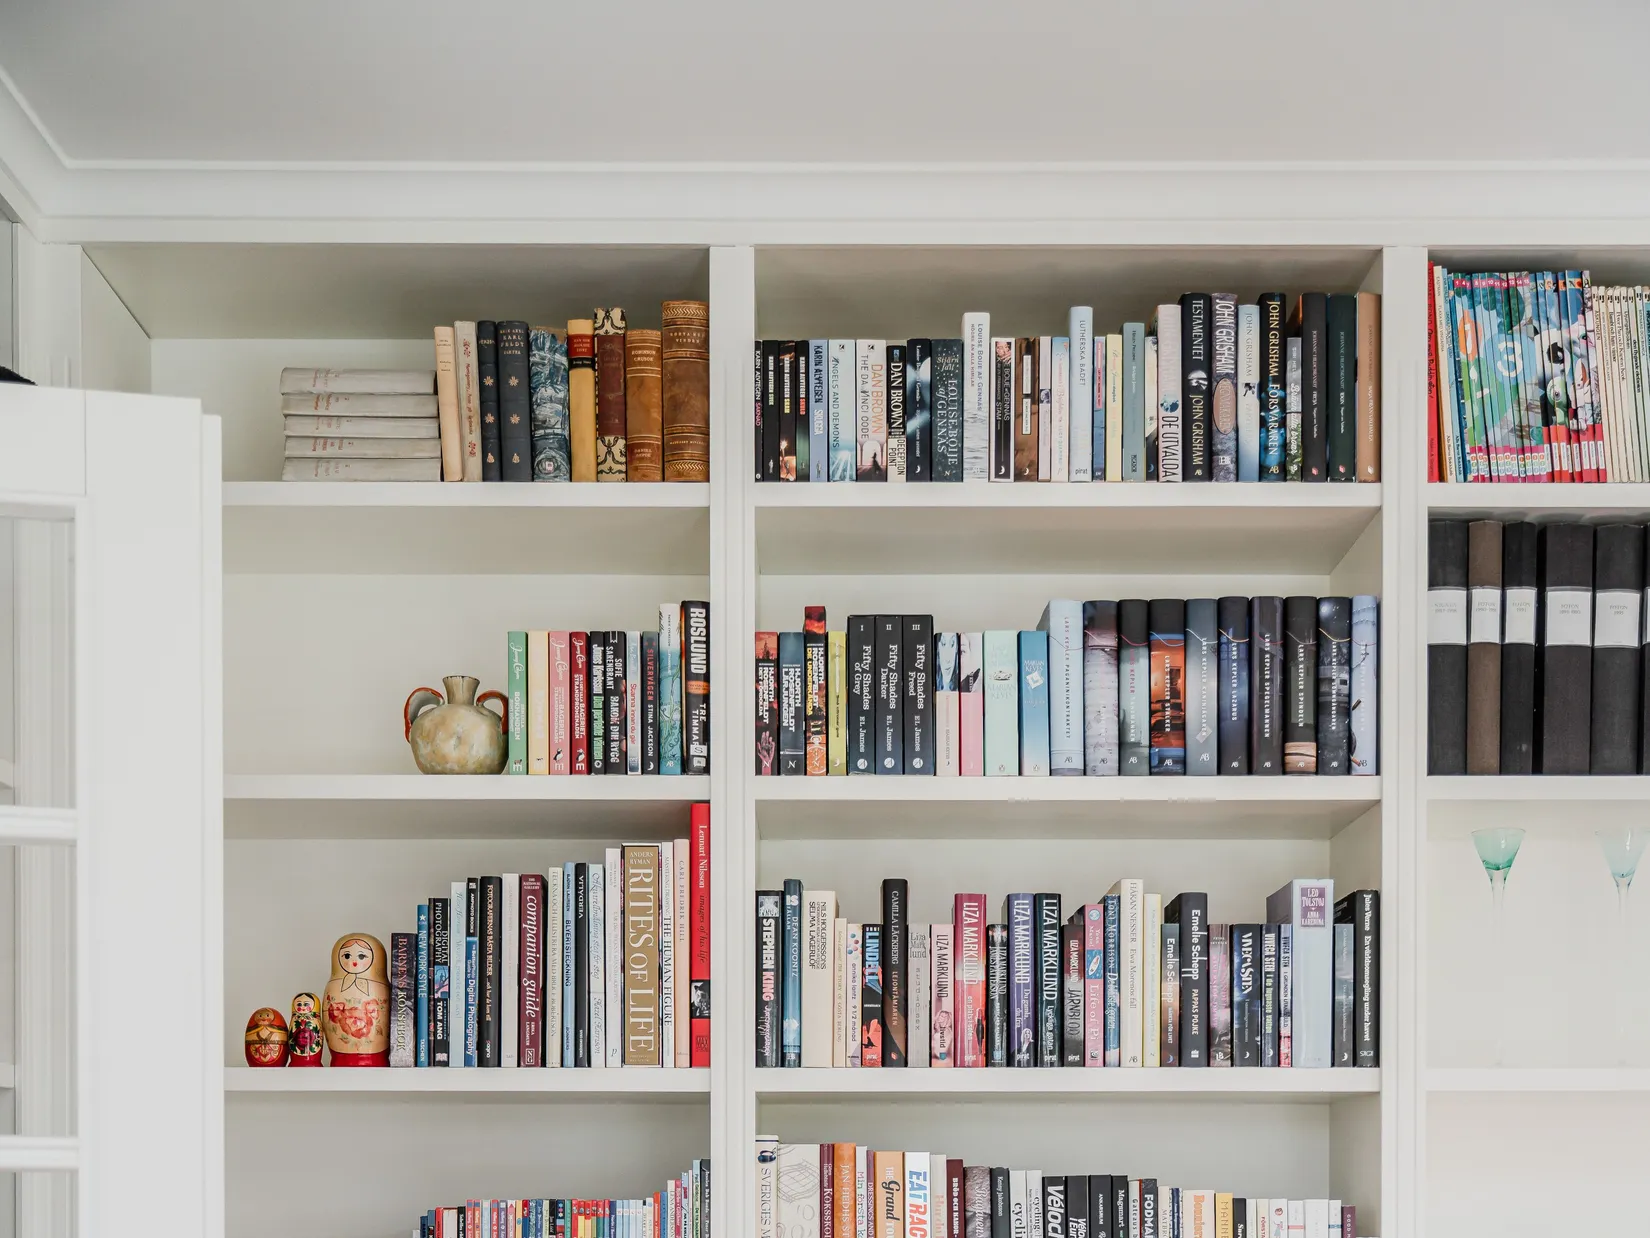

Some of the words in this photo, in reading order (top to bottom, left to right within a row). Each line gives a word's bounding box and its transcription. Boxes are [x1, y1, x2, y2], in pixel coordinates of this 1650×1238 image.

[1215, 299, 1235, 327] JOHN
[1244, 313, 1253, 335] JOHN
[1267, 301, 1281, 329] JOHN
[1079, 320, 1087, 361] LUTHERSKA
[1192, 300, 1204, 361] TESTAMENTET
[1215, 328, 1235, 374] GRISHAM
[1245, 337, 1253, 378] GRISHAM
[1268, 330, 1280, 377] GRISHAM
[831, 356, 840, 389] ANGELS
[870, 363, 884, 388] DAN
[890, 361, 903, 387] DAN
[1079, 364, 1087, 387] BADET
[832, 391, 840, 410] AND
[870, 390, 884, 435] BROWN
[889, 389, 903, 429] BROWN
[948, 379, 958, 425] LOUISE
[1189, 395, 1203, 421] JOHN
[832, 411, 841, 448] DEMONS
[1160, 415, 1179, 430] DE
[1268, 383, 1283, 455] FÖRSVARAREN
[888, 447, 897, 468] POINT
[896, 439, 906, 477] DECEPTION
[946, 430, 959, 466] BOIJE
[1160, 432, 1179, 478] UTVALDA
[1192, 422, 1204, 466] GRISHAM
[592, 644, 604, 664] Jonas
[690, 608, 706, 674] ROSLUND
[887, 644, 898, 670] Fifty
[915, 644, 926, 670] Fifty
[1231, 642, 1239, 660] LARS
[606, 646, 615, 690] SARENBRANT
[614, 658, 622, 678] SOFIE
[646, 648, 657, 701] SILVERVÄGEN
[860, 645, 871, 671] Fifty
[1231, 662, 1239, 687] KEPLER
[592, 666, 604, 693] Karlsson
[862, 673, 872, 711] Shades
[880, 669, 888, 700] Darker
[888, 672, 898, 710] Shades
[908, 672, 916, 697] Freed
[917, 672, 926, 709] Shades
[593, 696, 604, 708] Den
[609, 696, 620, 724] BAKOM
[782, 668, 790, 727] LÄRJUNGEN
[1231, 690, 1239, 721] LAZARUS
[591, 710, 604, 736] perfekte
[609, 725, 620, 740] DIN
[593, 737, 604, 759] vännen
[610, 741, 620, 763] RYGG
[698, 825, 708, 858] Lennart
[698, 860, 708, 889] Nilsson
[628, 867, 655, 949] RITES
[891, 890, 899, 924] CAMILLA
[1013, 900, 1032, 922] LIZA
[1042, 899, 1058, 926] LIZA
[1129, 882, 1139, 911] HÅKAN
[663, 916, 673, 939] THE
[791, 917, 799, 940] DEAN
[808, 901, 816, 928] SELMA
[963, 902, 979, 925] LIZA
[1129, 912, 1137, 943] NESSER
[418, 930, 427, 949] NEW
[435, 902, 443, 963] PHOTOGRAPHY
[441, 930, 449, 964] DIGITAL
[522, 895, 540, 975] companion
[762, 918, 775, 970] STEPHEN
[891, 925, 901, 965] LÄCKBERG
[935, 934, 949, 952] LIZA
[397, 937, 408, 988] BARNENS
[418, 950, 427, 973] YORK
[564, 920, 573, 987] BLYERTSTECKNING
[663, 941, 673, 984] HUMAN
[791, 943, 799, 978] KOONTZ
[808, 930, 818, 970] LAGERLÖF
[865, 931, 879, 985] LINDELL
[963, 927, 979, 985] MARKLUND
[1014, 924, 1031, 984] MARKLUND
[1043, 929, 1058, 1000] MARKLUND
[628, 953, 648, 983] OF
[935, 953, 949, 998] MARKLUND
[418, 974, 427, 998] STYLE
[465, 979, 476, 1004] Digital
[522, 978, 540, 1019] guide
[762, 971, 774, 1002] KING
[891, 971, 900, 1026] LEJONTÄMJAREN
[1191, 988, 1199, 1013] PAPPAS
[396, 991, 408, 1051] KONSTBOK
[628, 988, 655, 1052] LIFE
[663, 986, 673, 1027] FIGURE
[465, 1006, 476, 1056] Photography
[1191, 1014, 1199, 1035] POJKE
[841, 1164, 851, 1183] JAN
[908, 1170, 928, 1202] EAT
[759, 1167, 772, 1226] SVERIGES
[841, 1186, 851, 1222] HEDHS
[971, 1186, 989, 1238] Bagarens
[1116, 1189, 1126, 1228] Magsmart
